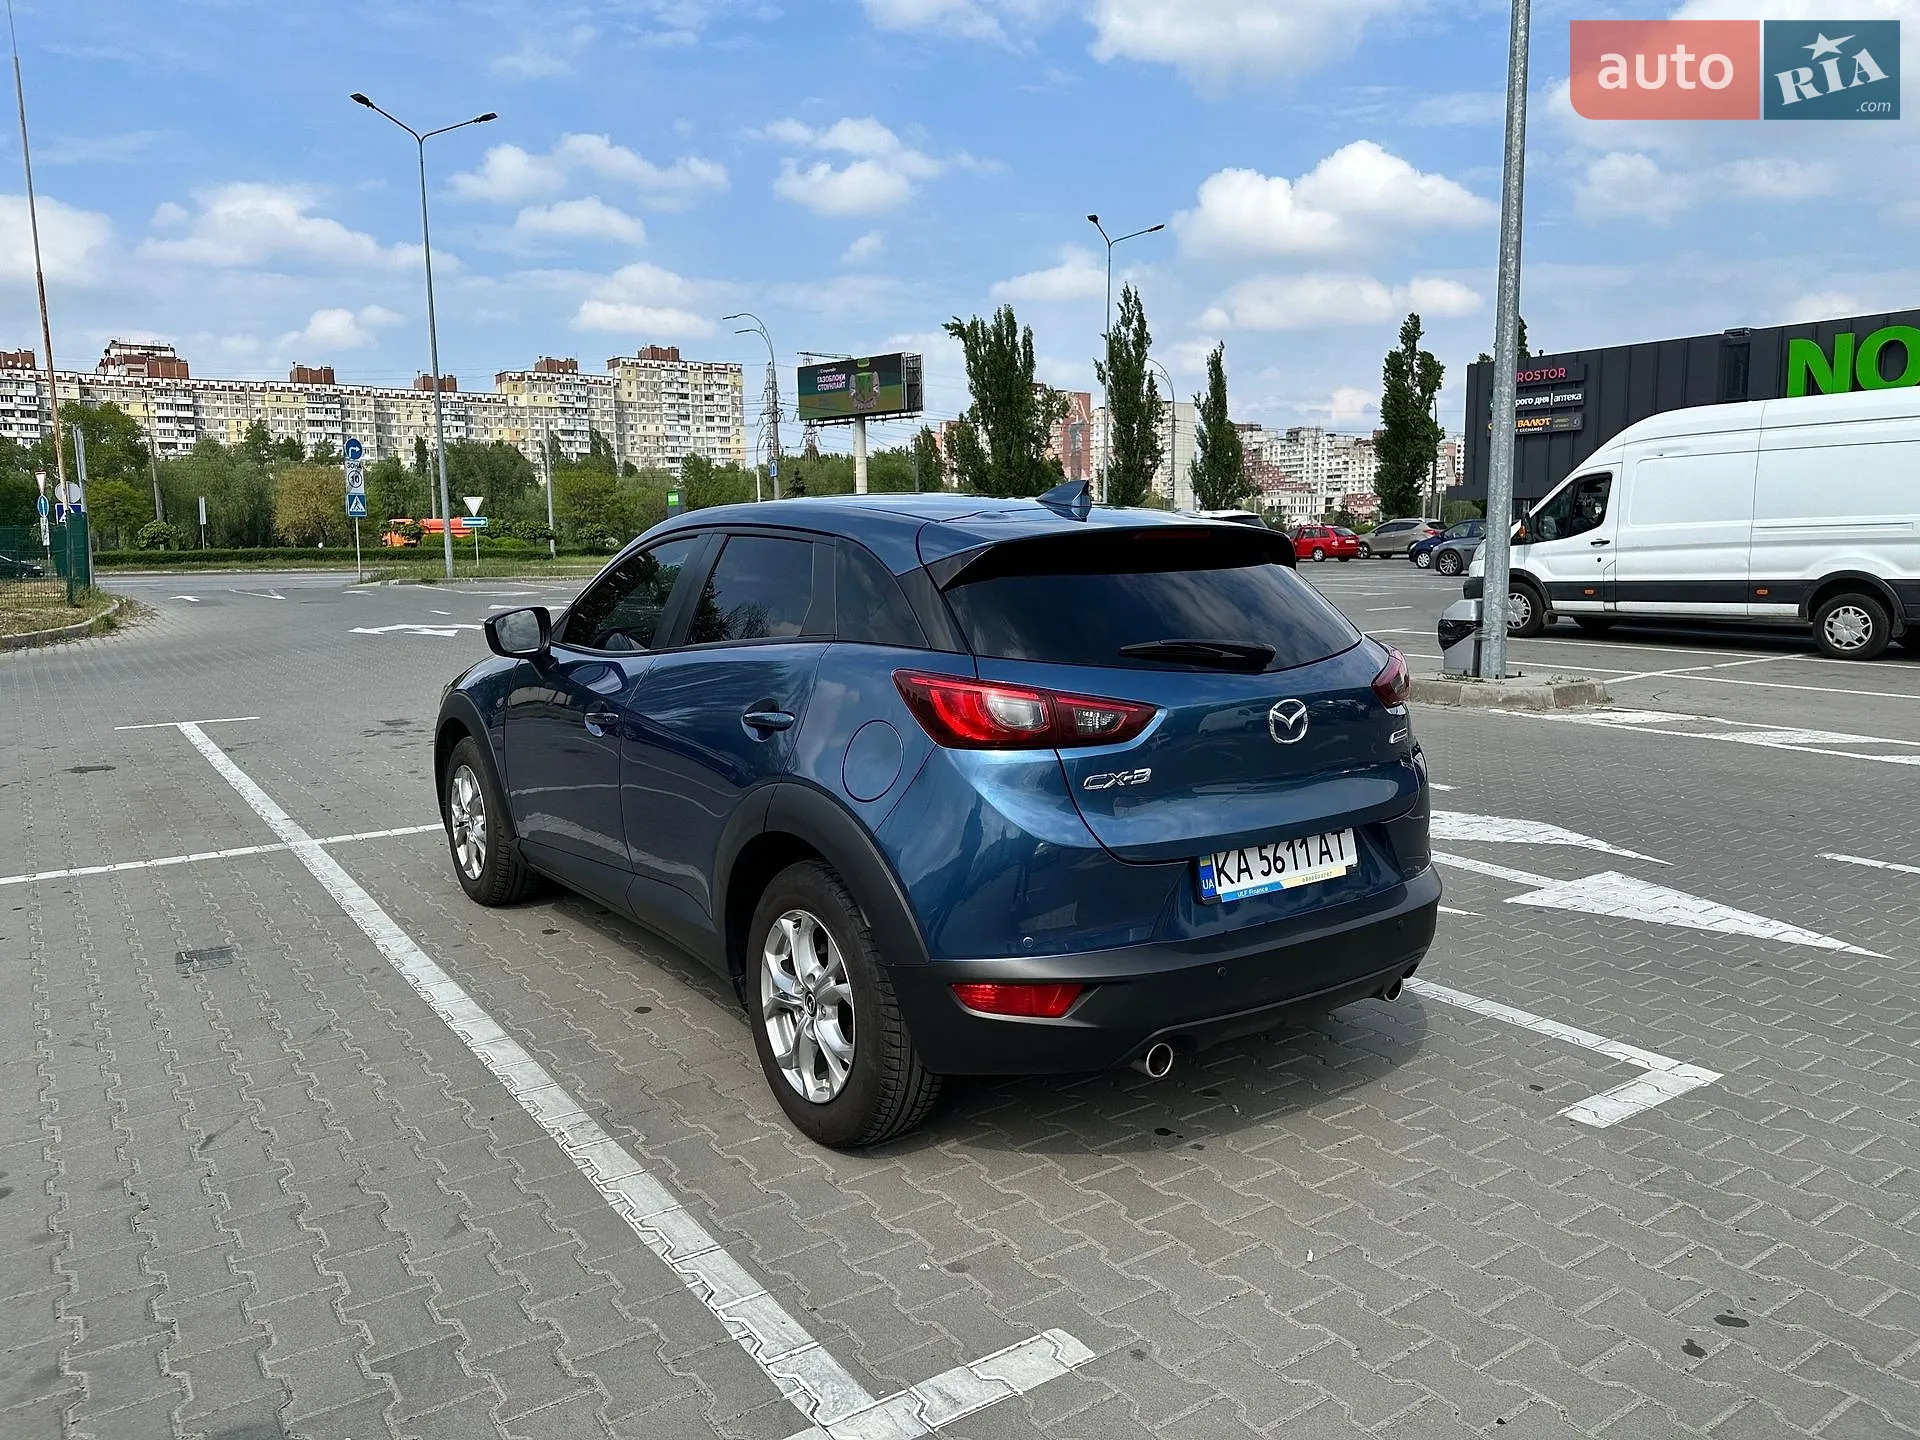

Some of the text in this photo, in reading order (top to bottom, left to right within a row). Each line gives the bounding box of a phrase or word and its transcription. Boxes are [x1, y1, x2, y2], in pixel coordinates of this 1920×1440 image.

[1516, 368, 1567, 382] ROSTOR
[1515, 393, 1582, 408] рого дня аптека
[1517, 417, 1552, 428] ВАЛЮТ
[351, 475, 360, 484] 10
[1083, 768, 1152, 790] CX-3
[1258, 838, 1312, 877] 5611
[1202, 878, 1215, 890] UA
